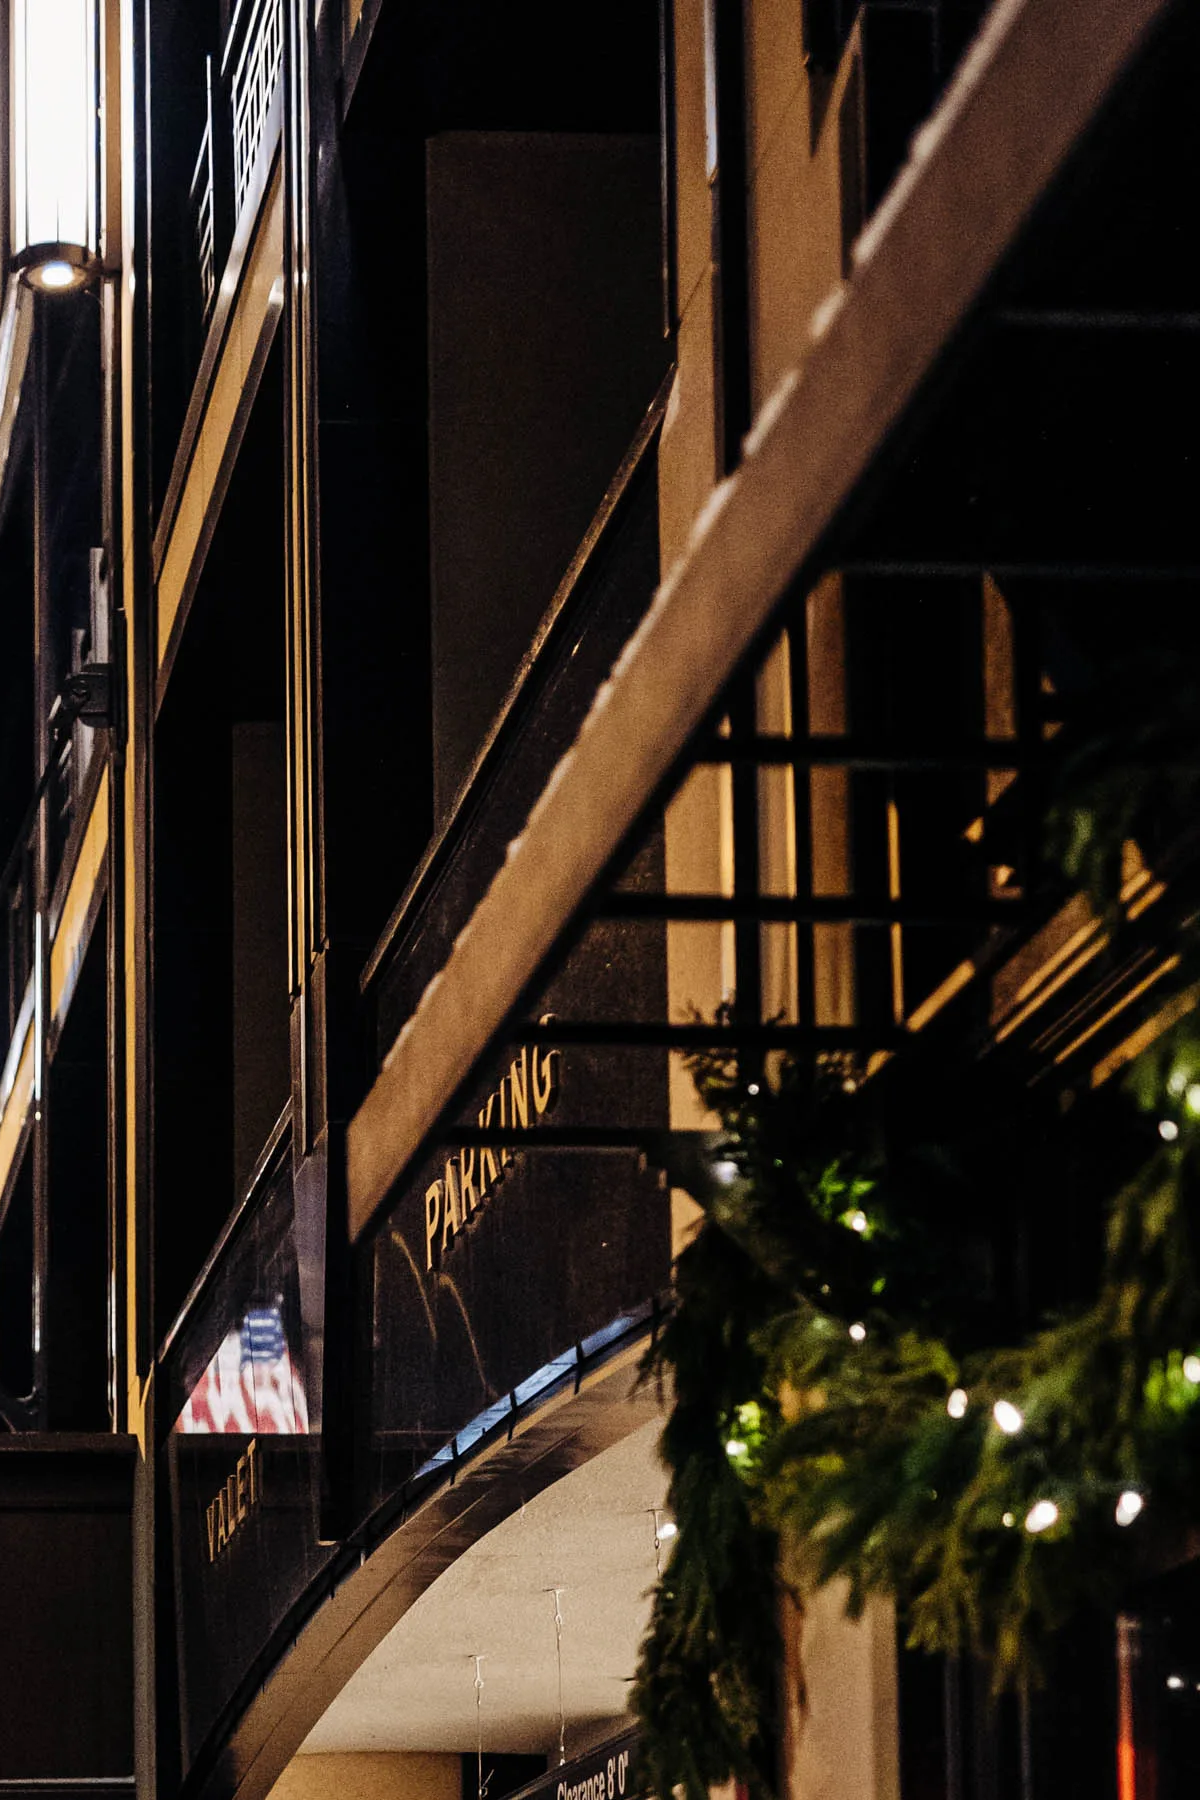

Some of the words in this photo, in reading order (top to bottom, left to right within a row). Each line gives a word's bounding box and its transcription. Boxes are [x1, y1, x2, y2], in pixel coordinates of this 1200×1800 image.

[425, 1013, 560, 1272] PARKING
[206, 1437, 256, 1562] VALET
[607, 1756, 617, 1800] 8'
